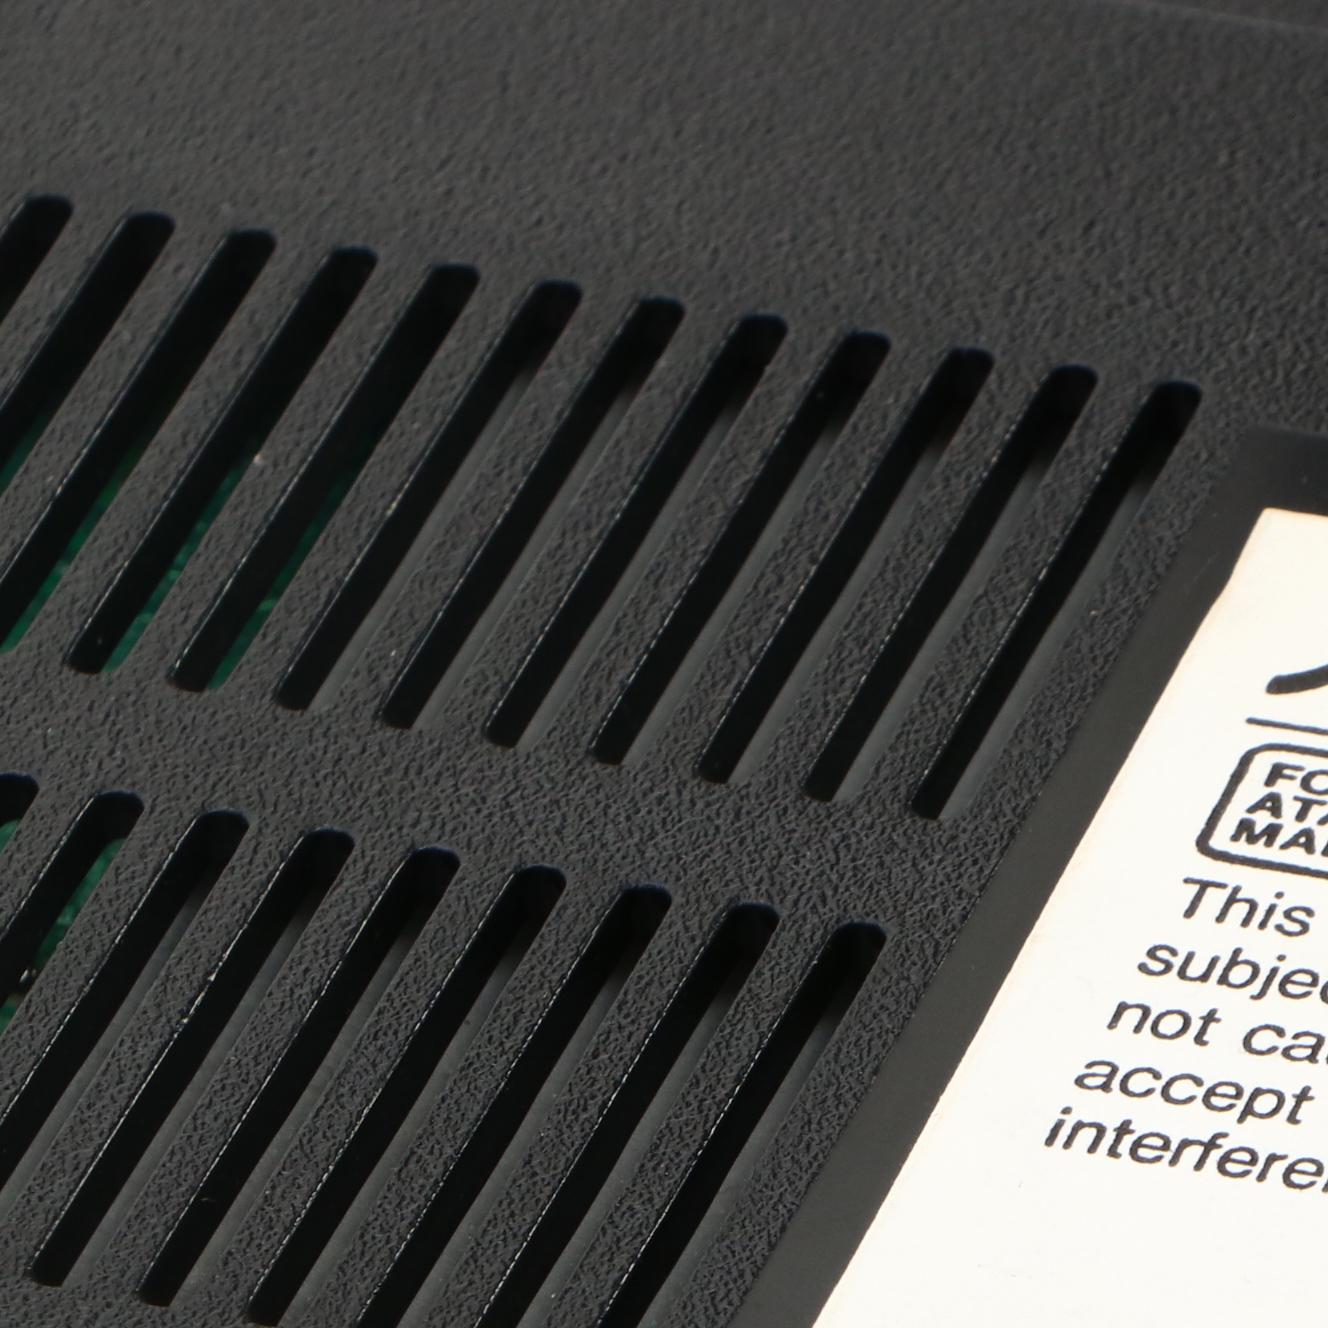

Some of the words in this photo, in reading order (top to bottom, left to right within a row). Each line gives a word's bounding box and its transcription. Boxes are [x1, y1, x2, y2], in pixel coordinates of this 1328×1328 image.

[1182, 876, 1315, 938] This
[1106, 1000, 1222, 1048] not
[1073, 1059, 1315, 1126] accept
